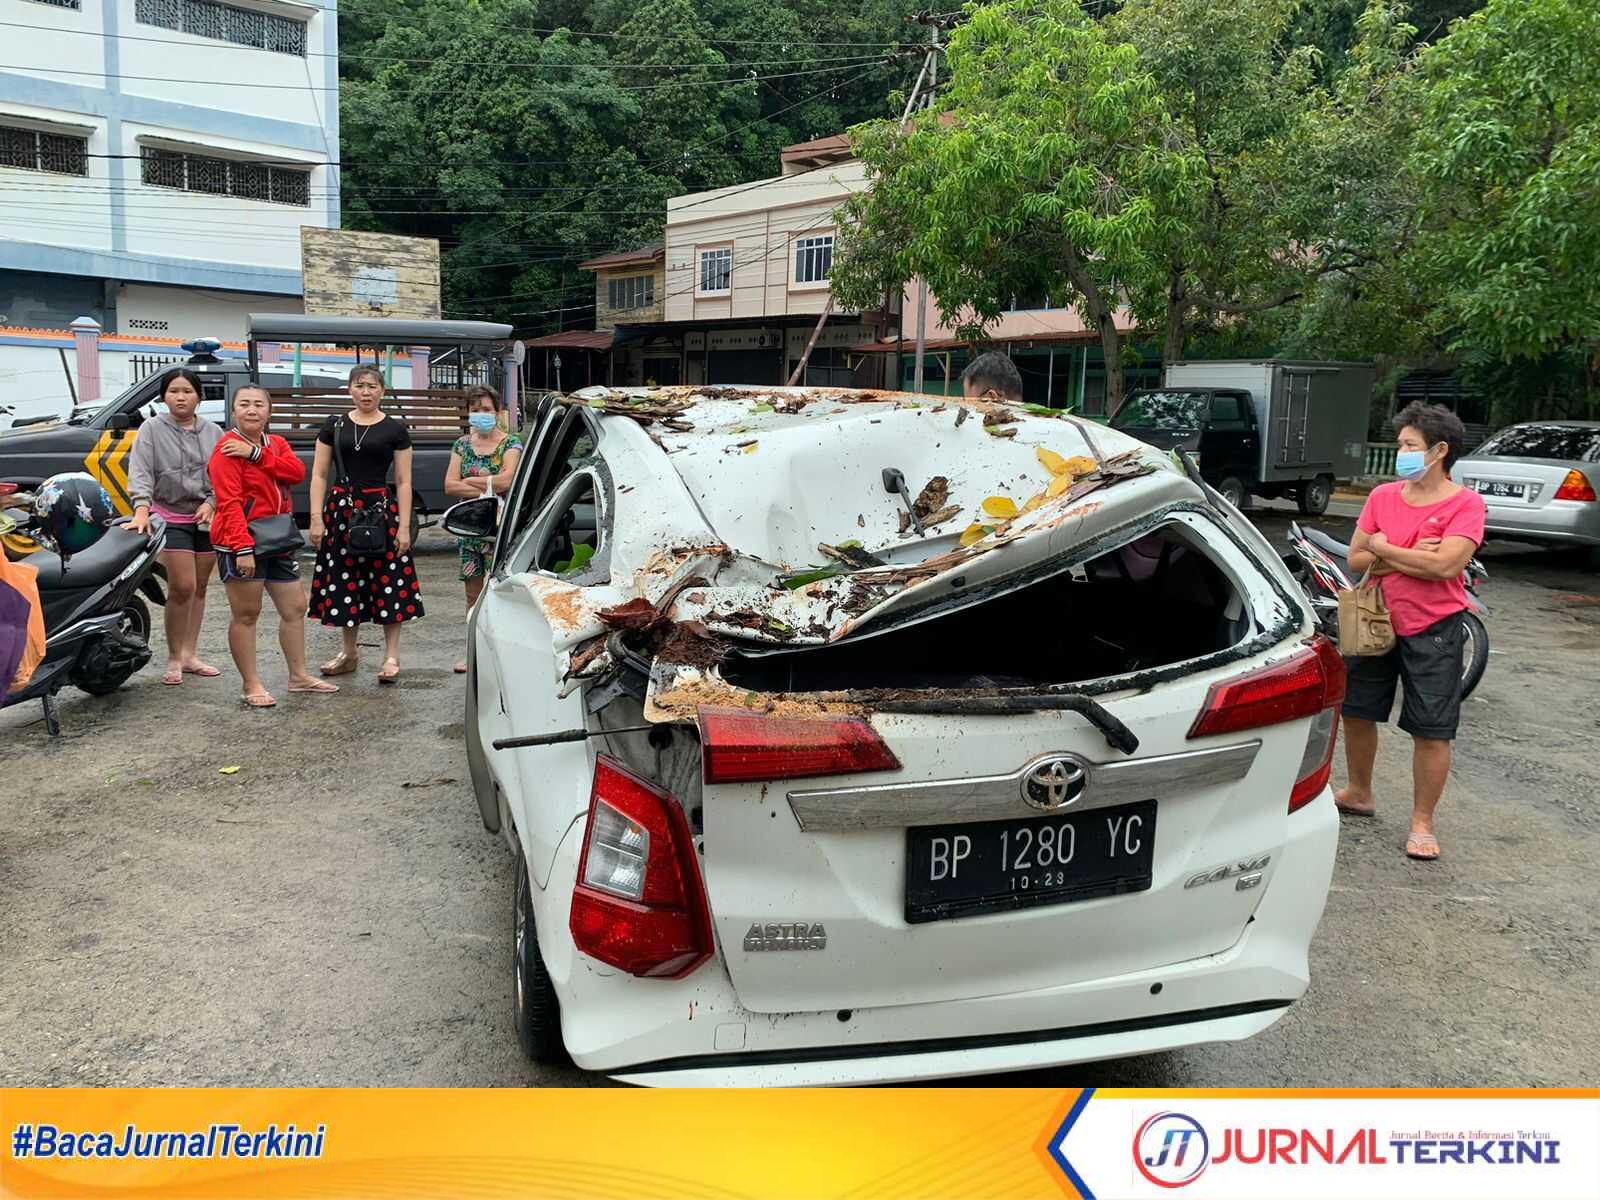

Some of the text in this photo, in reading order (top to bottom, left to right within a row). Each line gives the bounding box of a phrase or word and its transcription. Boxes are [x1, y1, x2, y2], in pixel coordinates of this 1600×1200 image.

[930, 815, 1143, 881] BP 1280 YC
[744, 921, 827, 940] ASTRA
